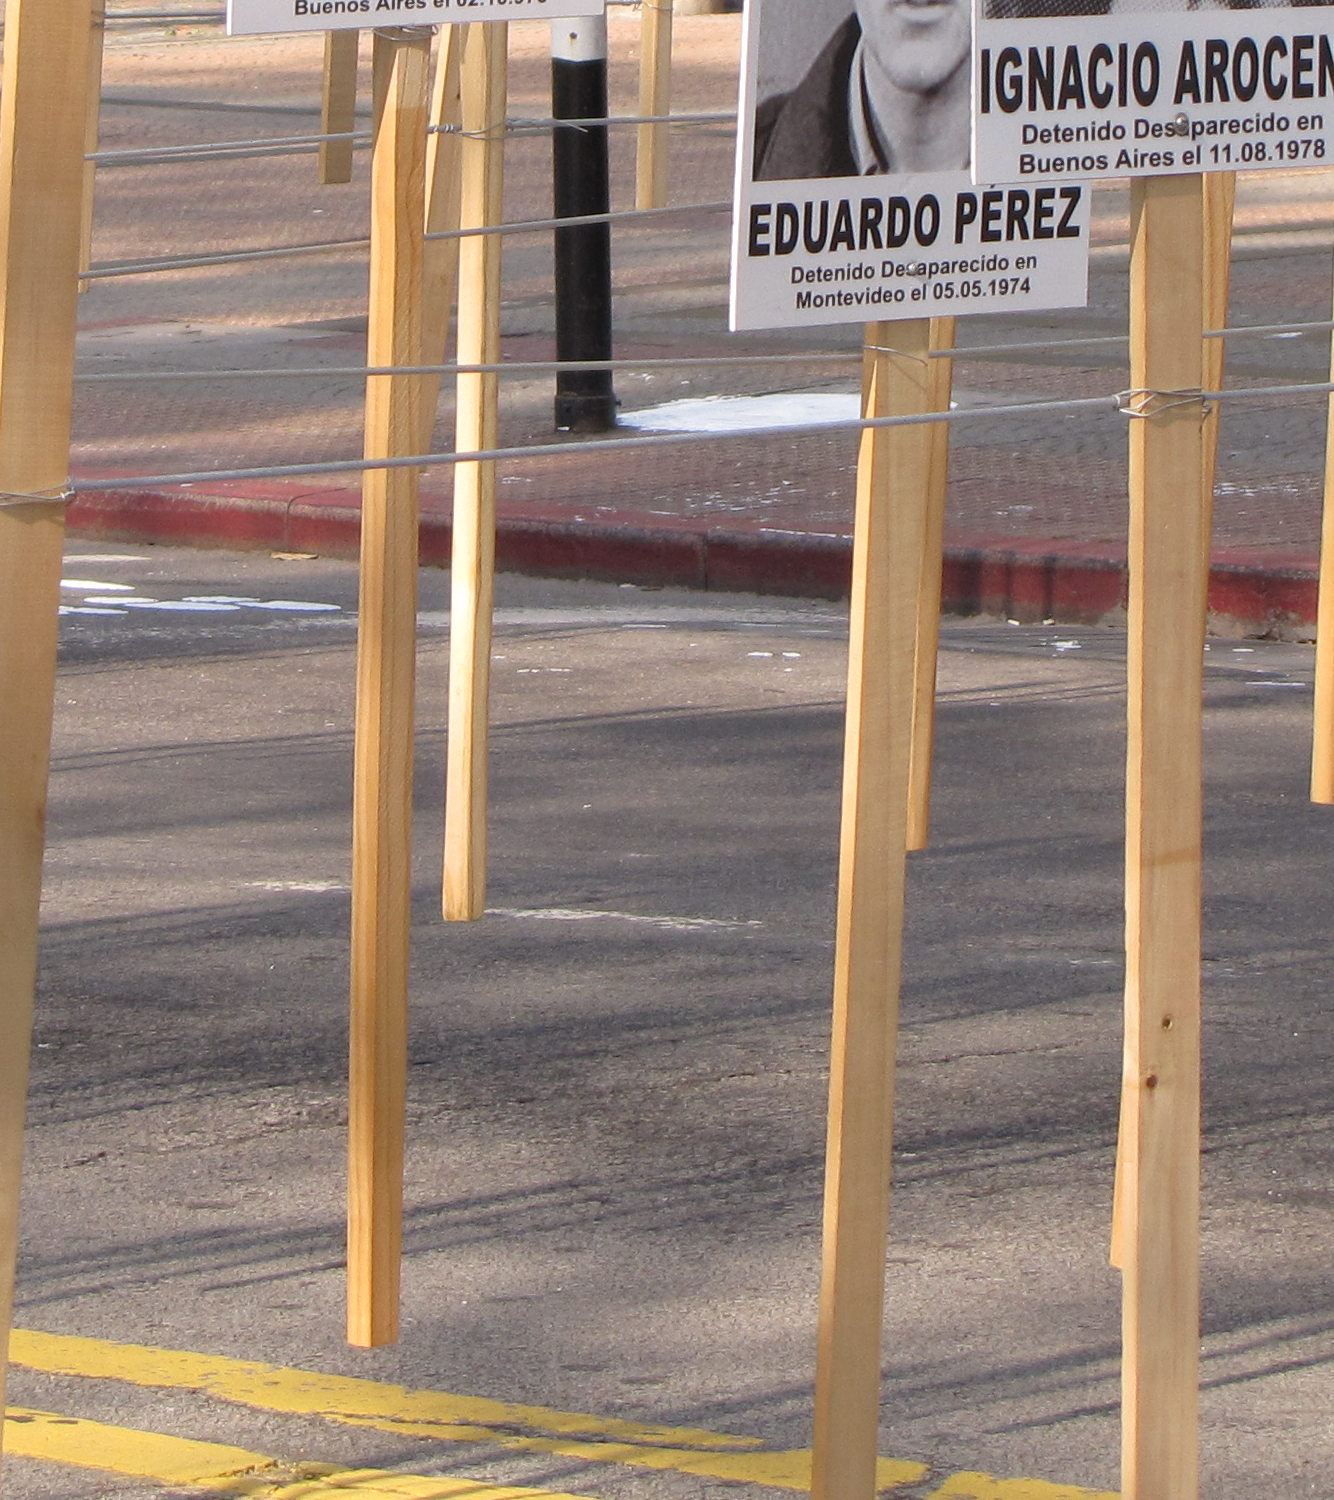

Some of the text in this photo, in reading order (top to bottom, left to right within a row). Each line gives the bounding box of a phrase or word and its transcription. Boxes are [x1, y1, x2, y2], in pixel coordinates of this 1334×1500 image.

[980, 41, 1161, 114] IGNACIO
[1022, 119, 1126, 145] Detenido
[1297, 115, 1323, 132] en
[1019, 139, 1325, 175] Buenos Aires el 11.08.1978
[748, 184, 1082, 257] EDUARDO PÉREZ
[791, 260, 875, 285] Detenido
[1015, 256, 1037, 271] en
[796, 277, 1031, 310] Montevideo el 05.05.1974
